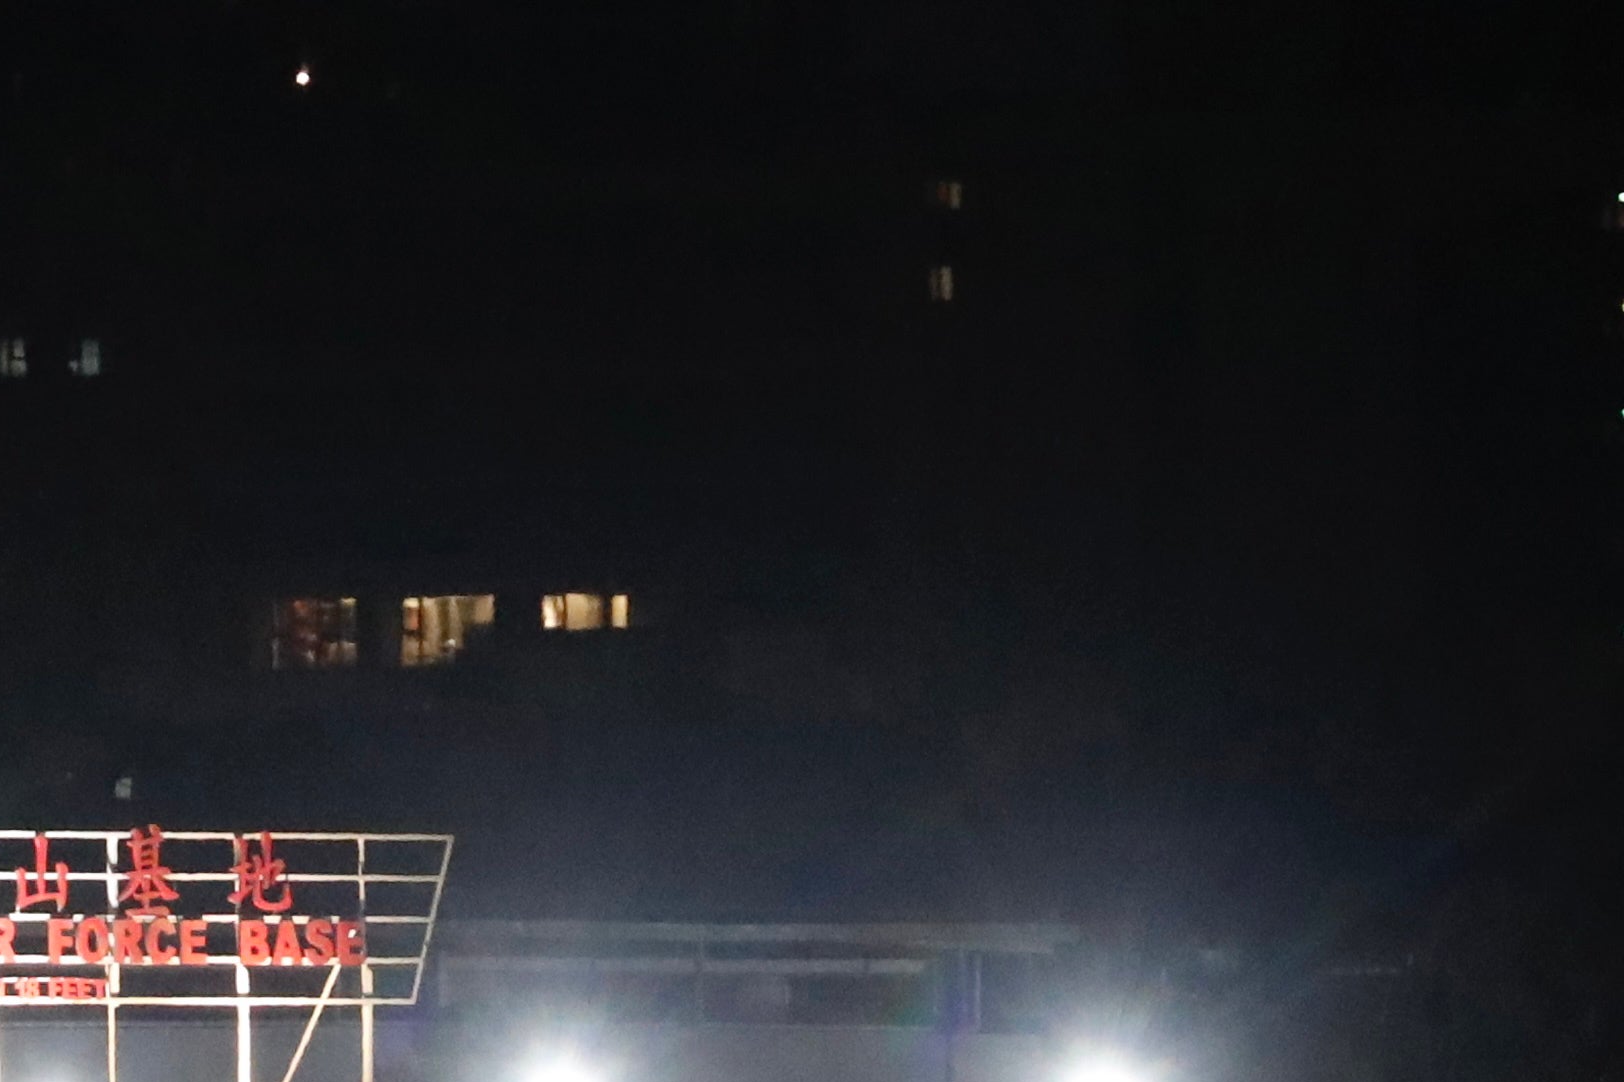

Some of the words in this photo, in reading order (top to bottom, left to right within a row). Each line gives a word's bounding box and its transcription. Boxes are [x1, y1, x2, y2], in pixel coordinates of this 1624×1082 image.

[47, 917, 209, 966] FORCE
[238, 918, 368, 966] BASE
[49, 978, 108, 1000] FEET
